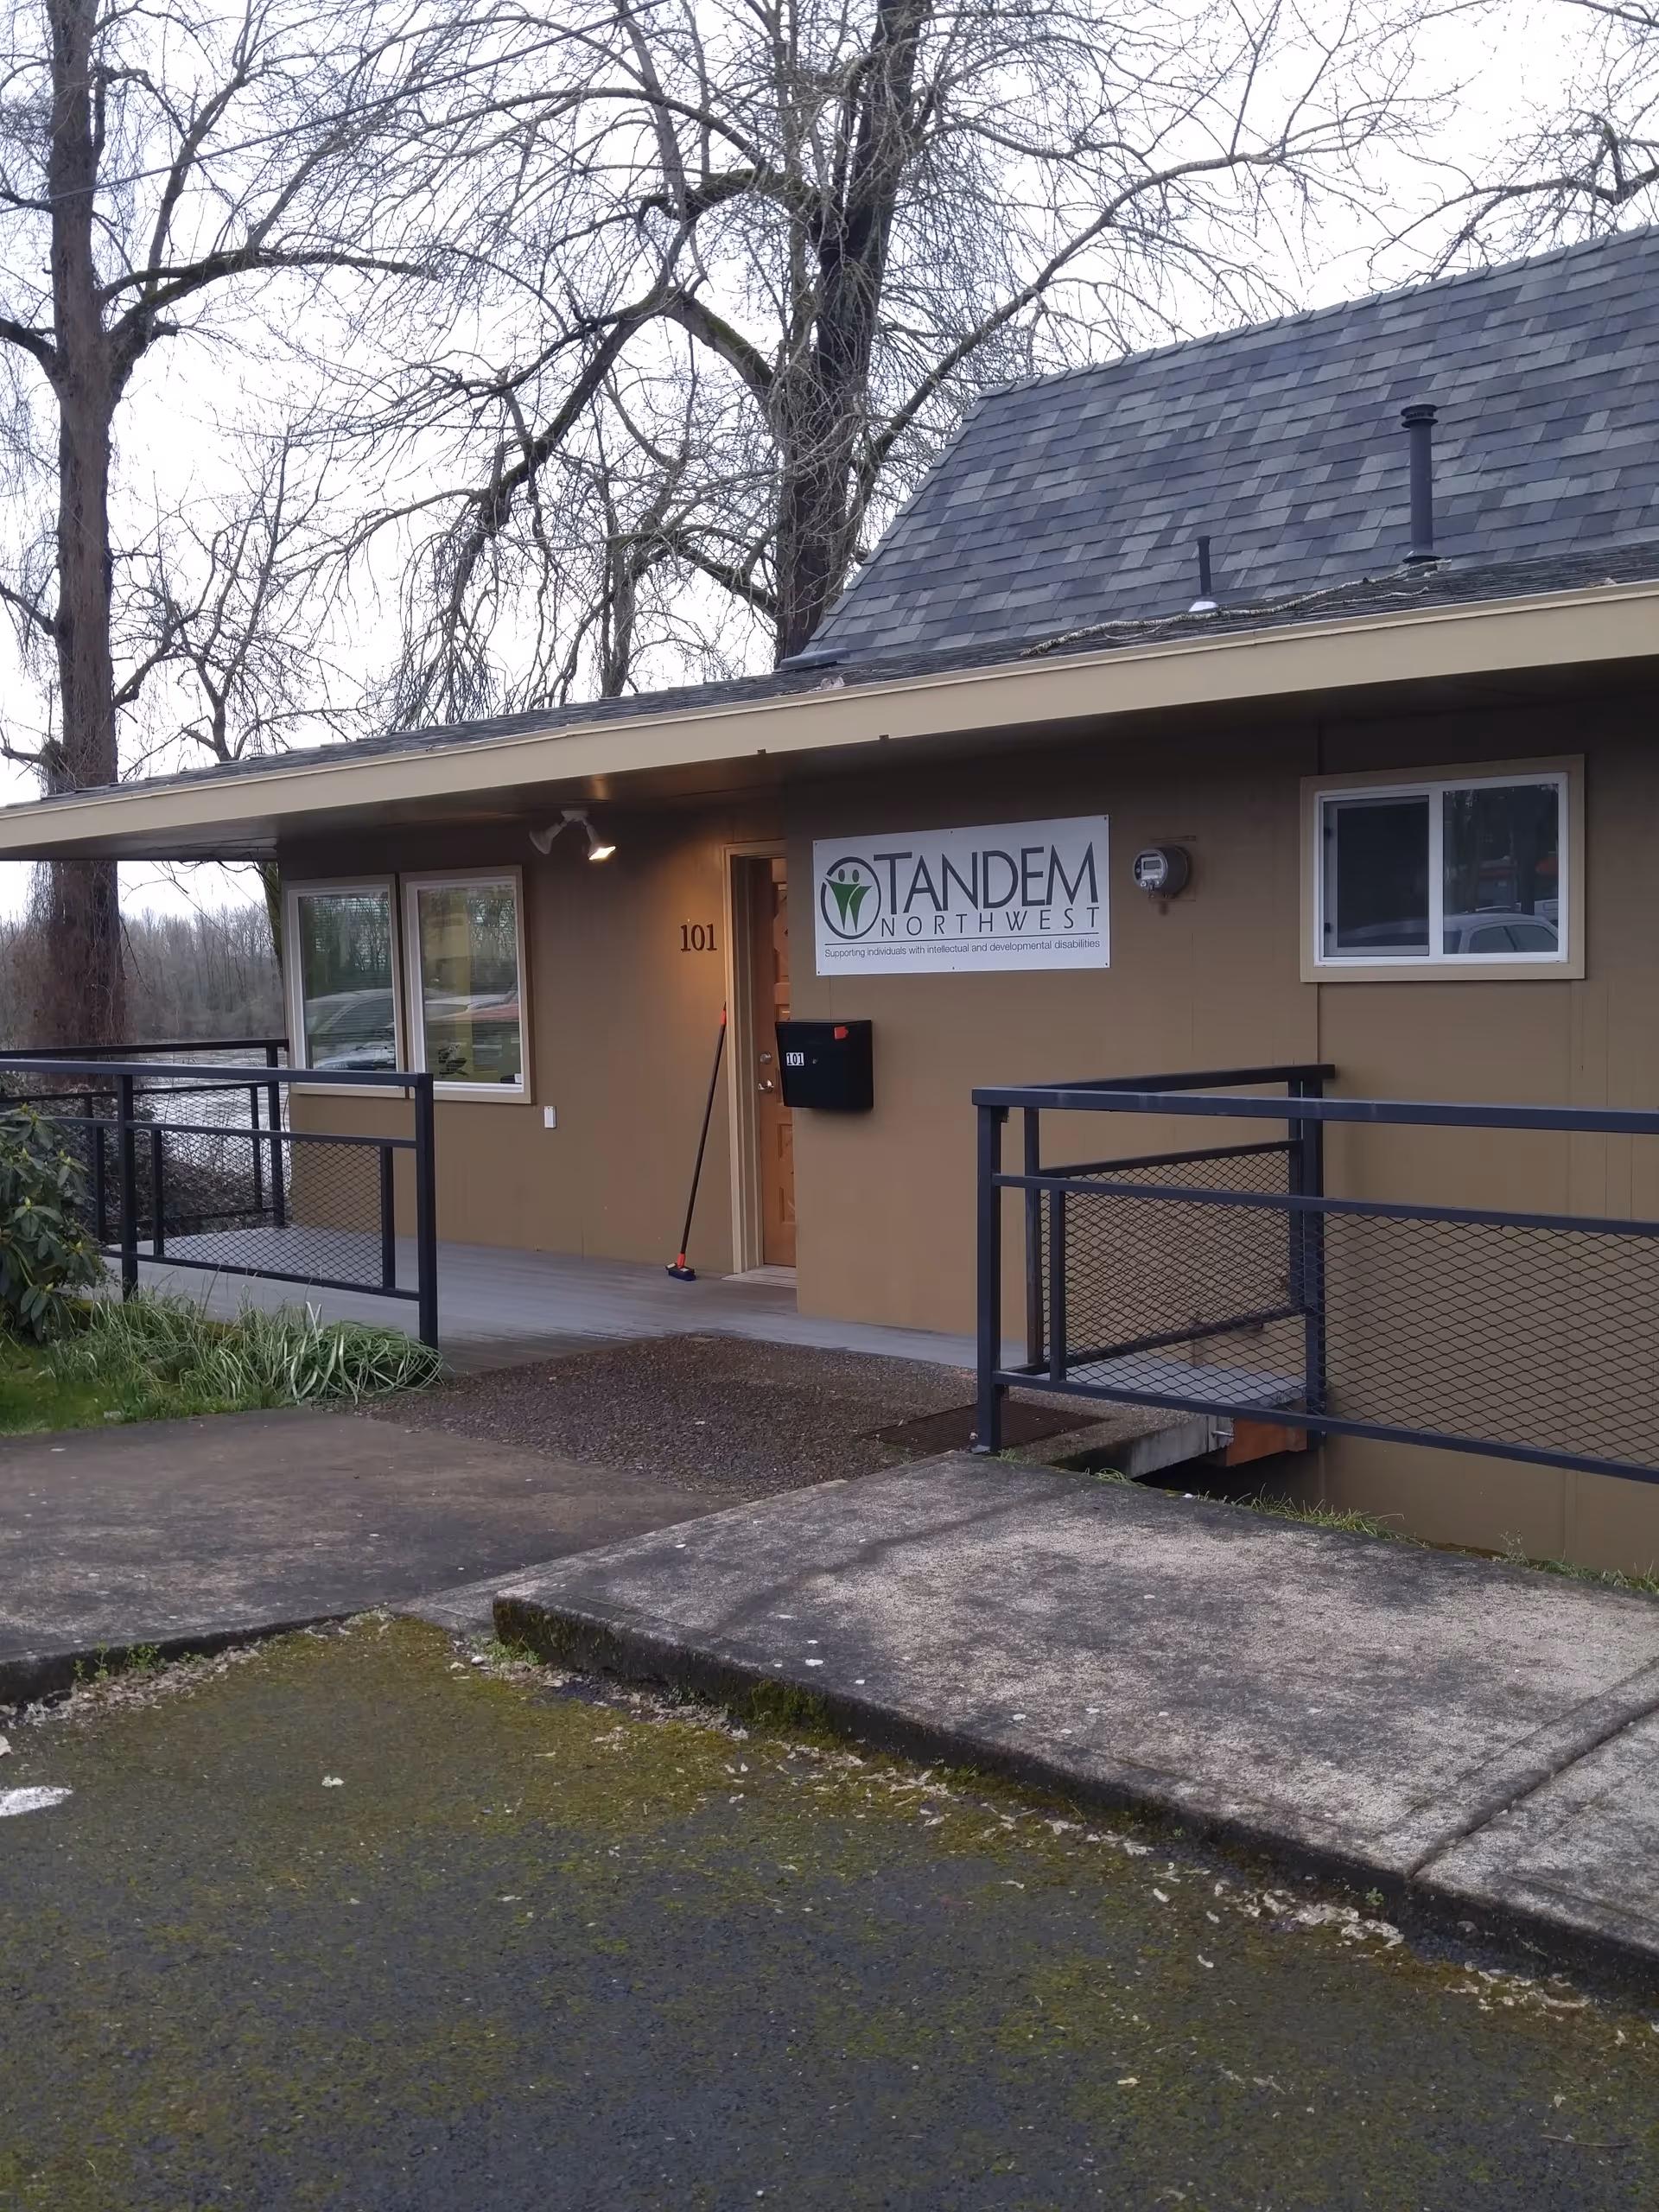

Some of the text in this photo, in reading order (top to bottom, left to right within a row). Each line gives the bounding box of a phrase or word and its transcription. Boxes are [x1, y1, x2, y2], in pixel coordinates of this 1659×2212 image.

[873, 842, 1099, 915] TANDEM
[881, 907, 1100, 938] NORTHWEST
[681, 924, 717, 951] 101
[824, 938, 1100, 958] Supporting individuals with intellectual and developmental disabilities
[786, 1053, 804, 1065] 101
